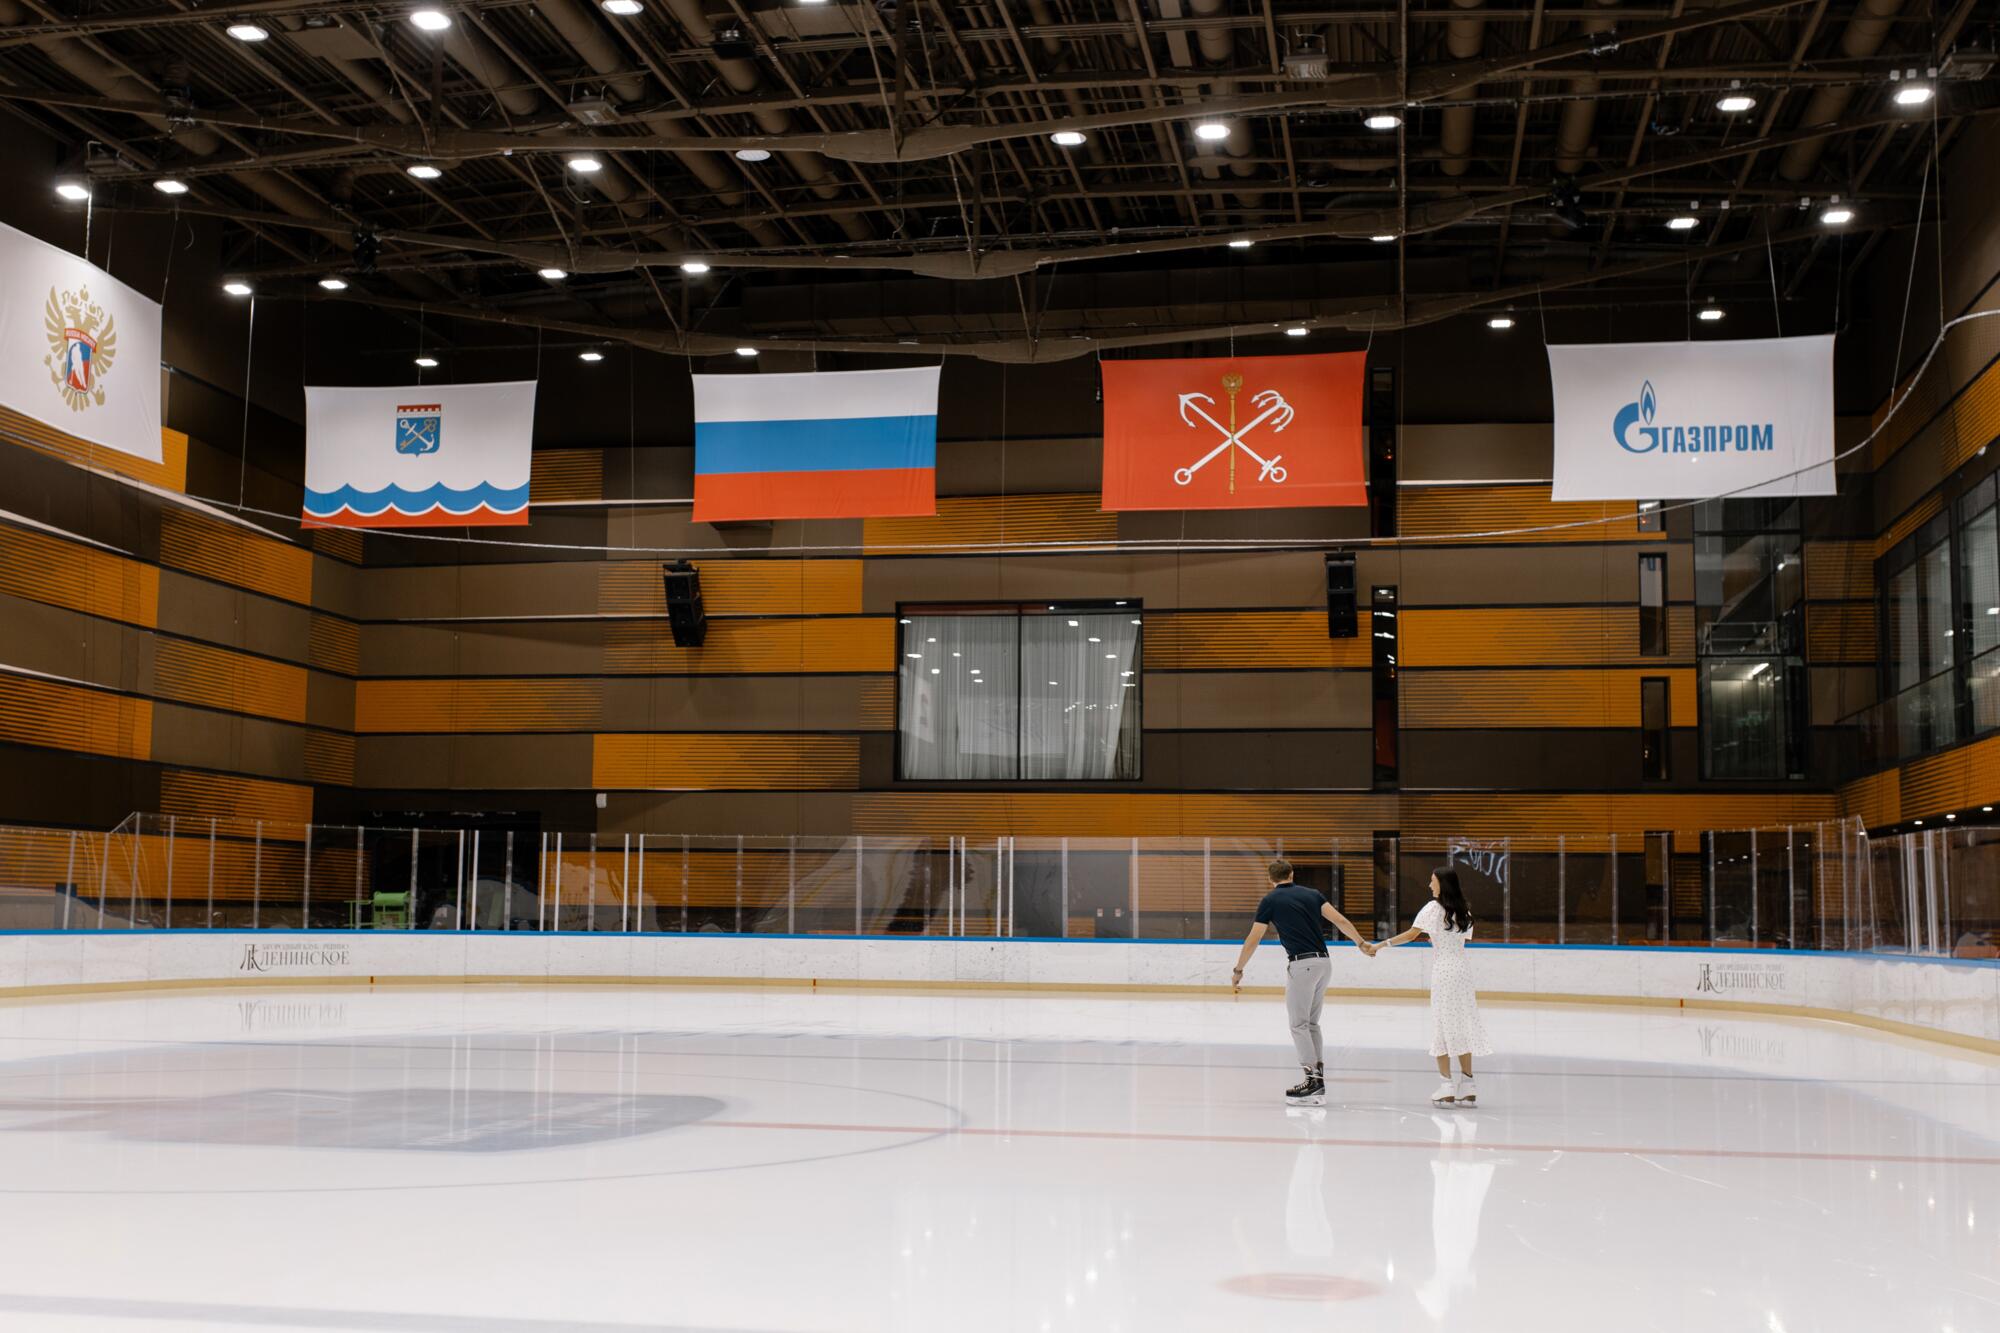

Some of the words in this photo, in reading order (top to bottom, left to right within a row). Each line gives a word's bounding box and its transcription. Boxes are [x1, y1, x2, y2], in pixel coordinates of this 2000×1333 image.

[1661, 424, 1773, 453] ГАЗПРОМ
[260, 951, 350, 966] ЛЕНИНСКОЕ
[1715, 972, 1785, 990] ЛЕНИНСКОЕ
